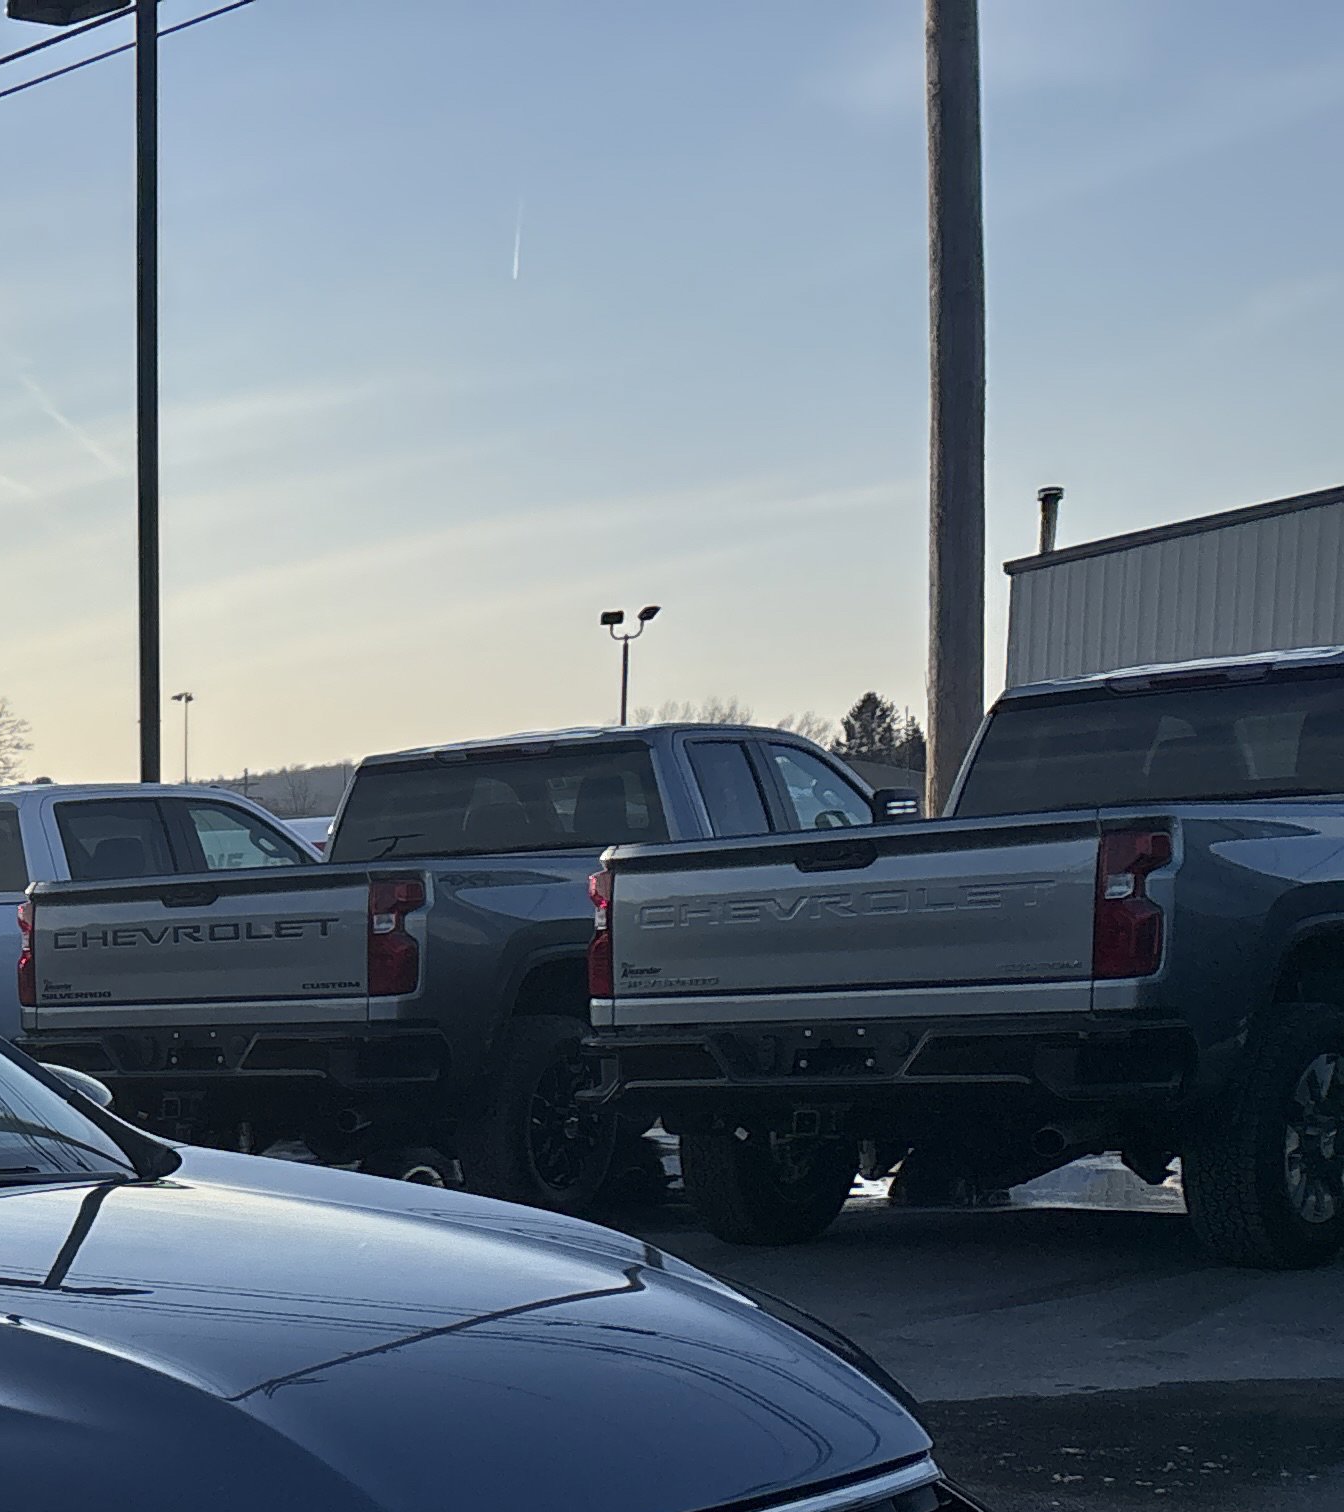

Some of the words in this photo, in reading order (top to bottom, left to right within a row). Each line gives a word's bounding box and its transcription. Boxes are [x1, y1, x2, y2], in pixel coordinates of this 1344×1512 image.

[636, 878, 1057, 931] CHEVROLET
[53, 917, 339, 952] CHEVROLET
[41, 991, 112, 1000] SILVERADO
[302, 981, 361, 990] CUSTOM
